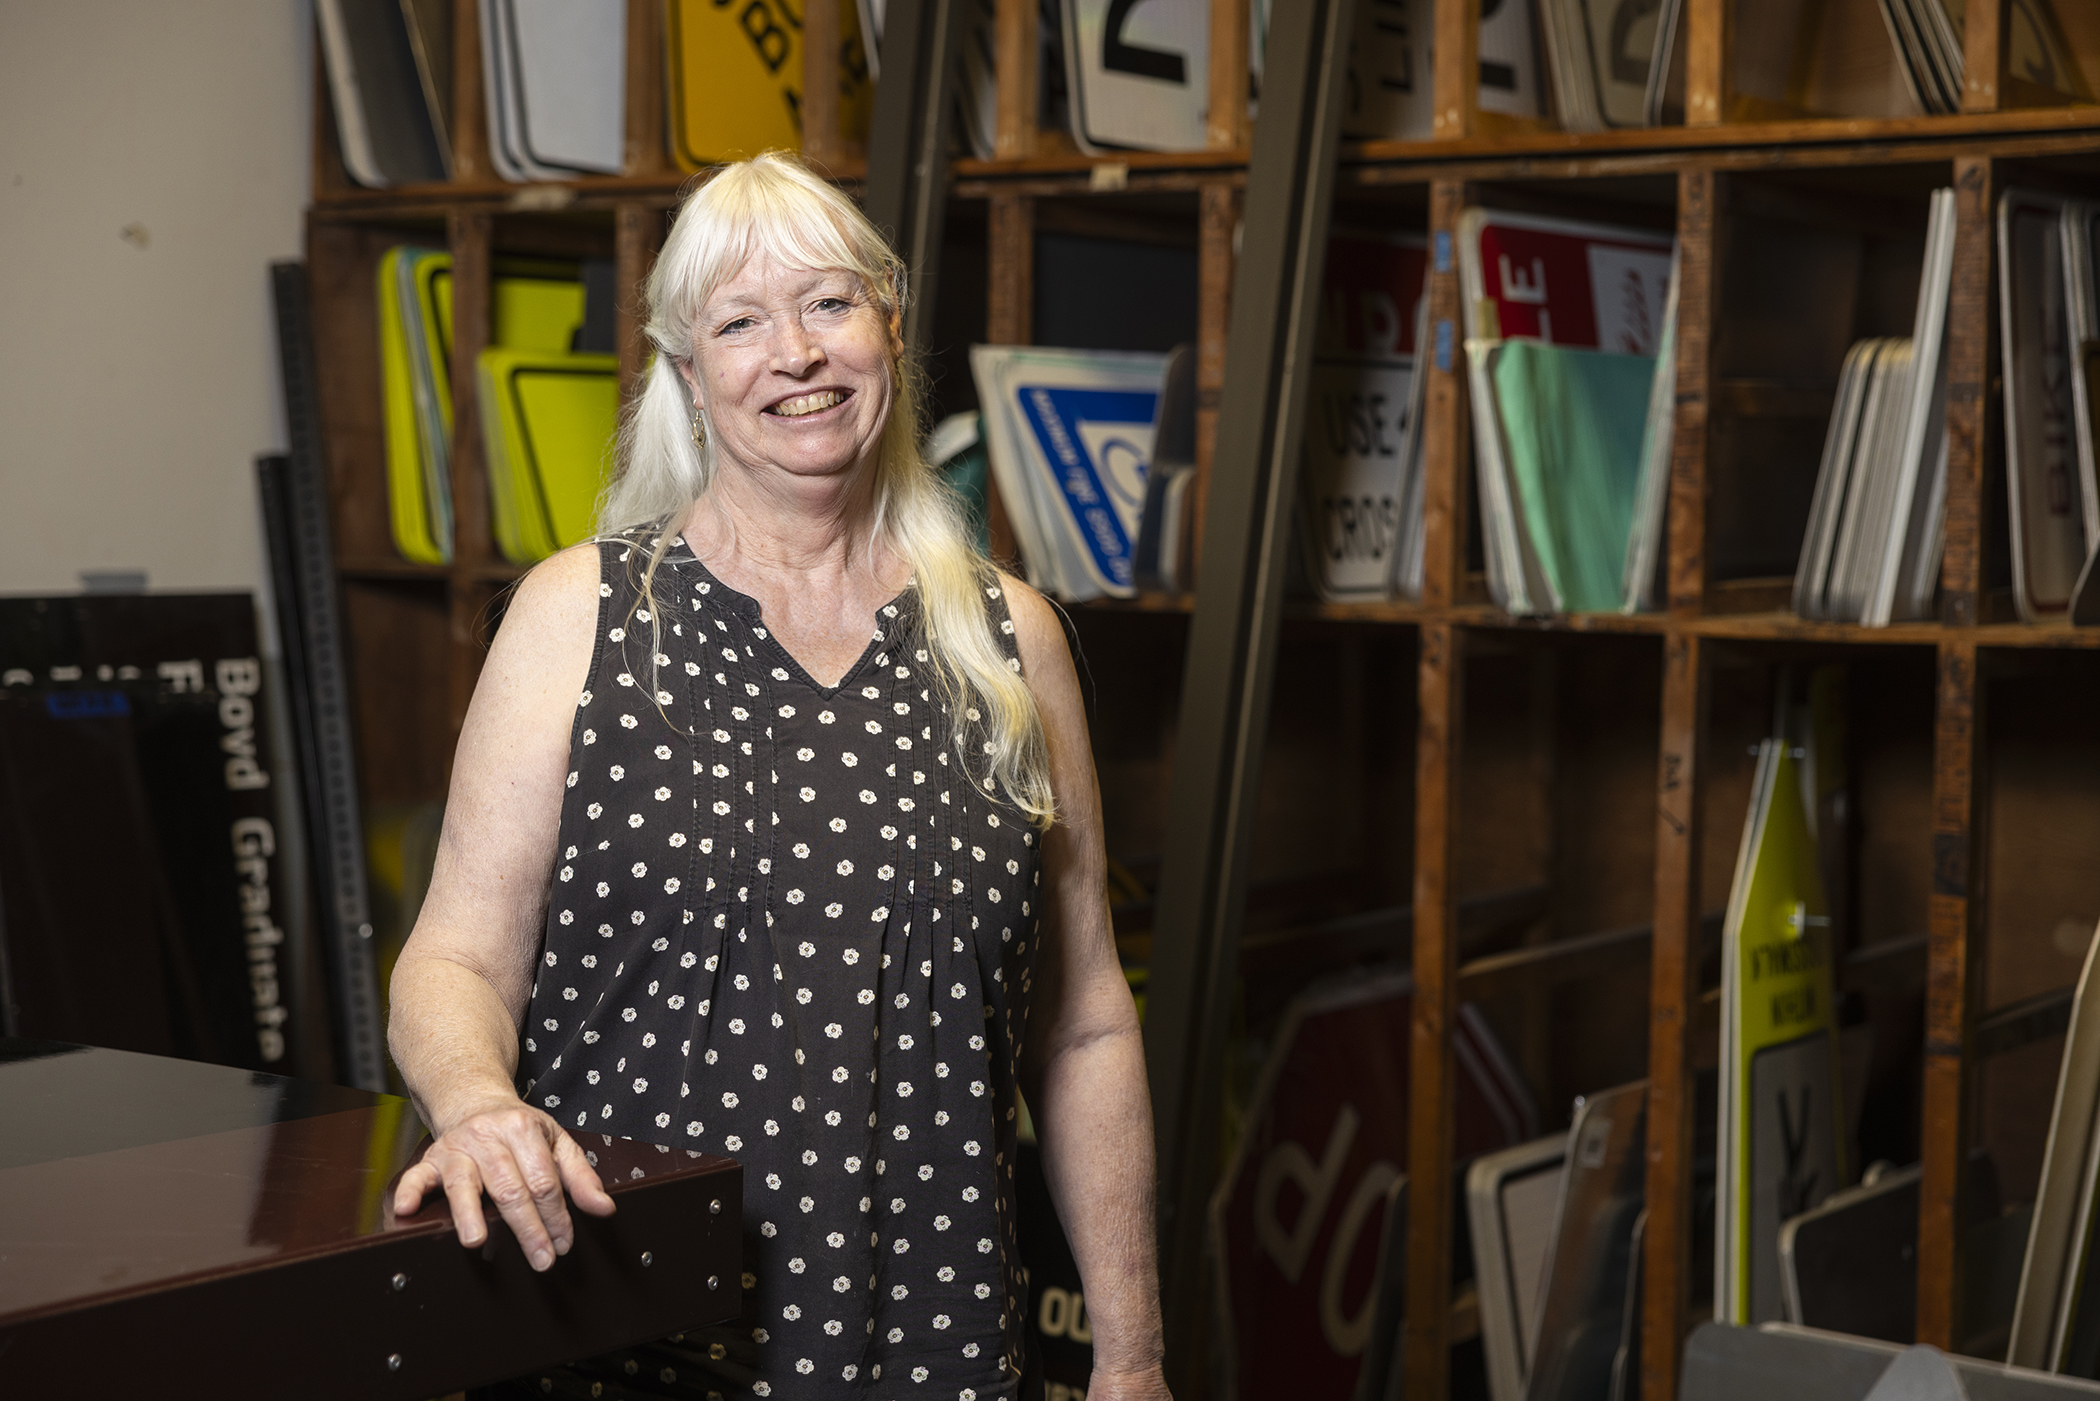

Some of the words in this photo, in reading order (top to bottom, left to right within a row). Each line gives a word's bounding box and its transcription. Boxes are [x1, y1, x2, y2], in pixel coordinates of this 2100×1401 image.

[1322, 393, 1393, 456] USE
[217, 658, 270, 789] Boyd
[232, 818, 287, 1063] Graduate
